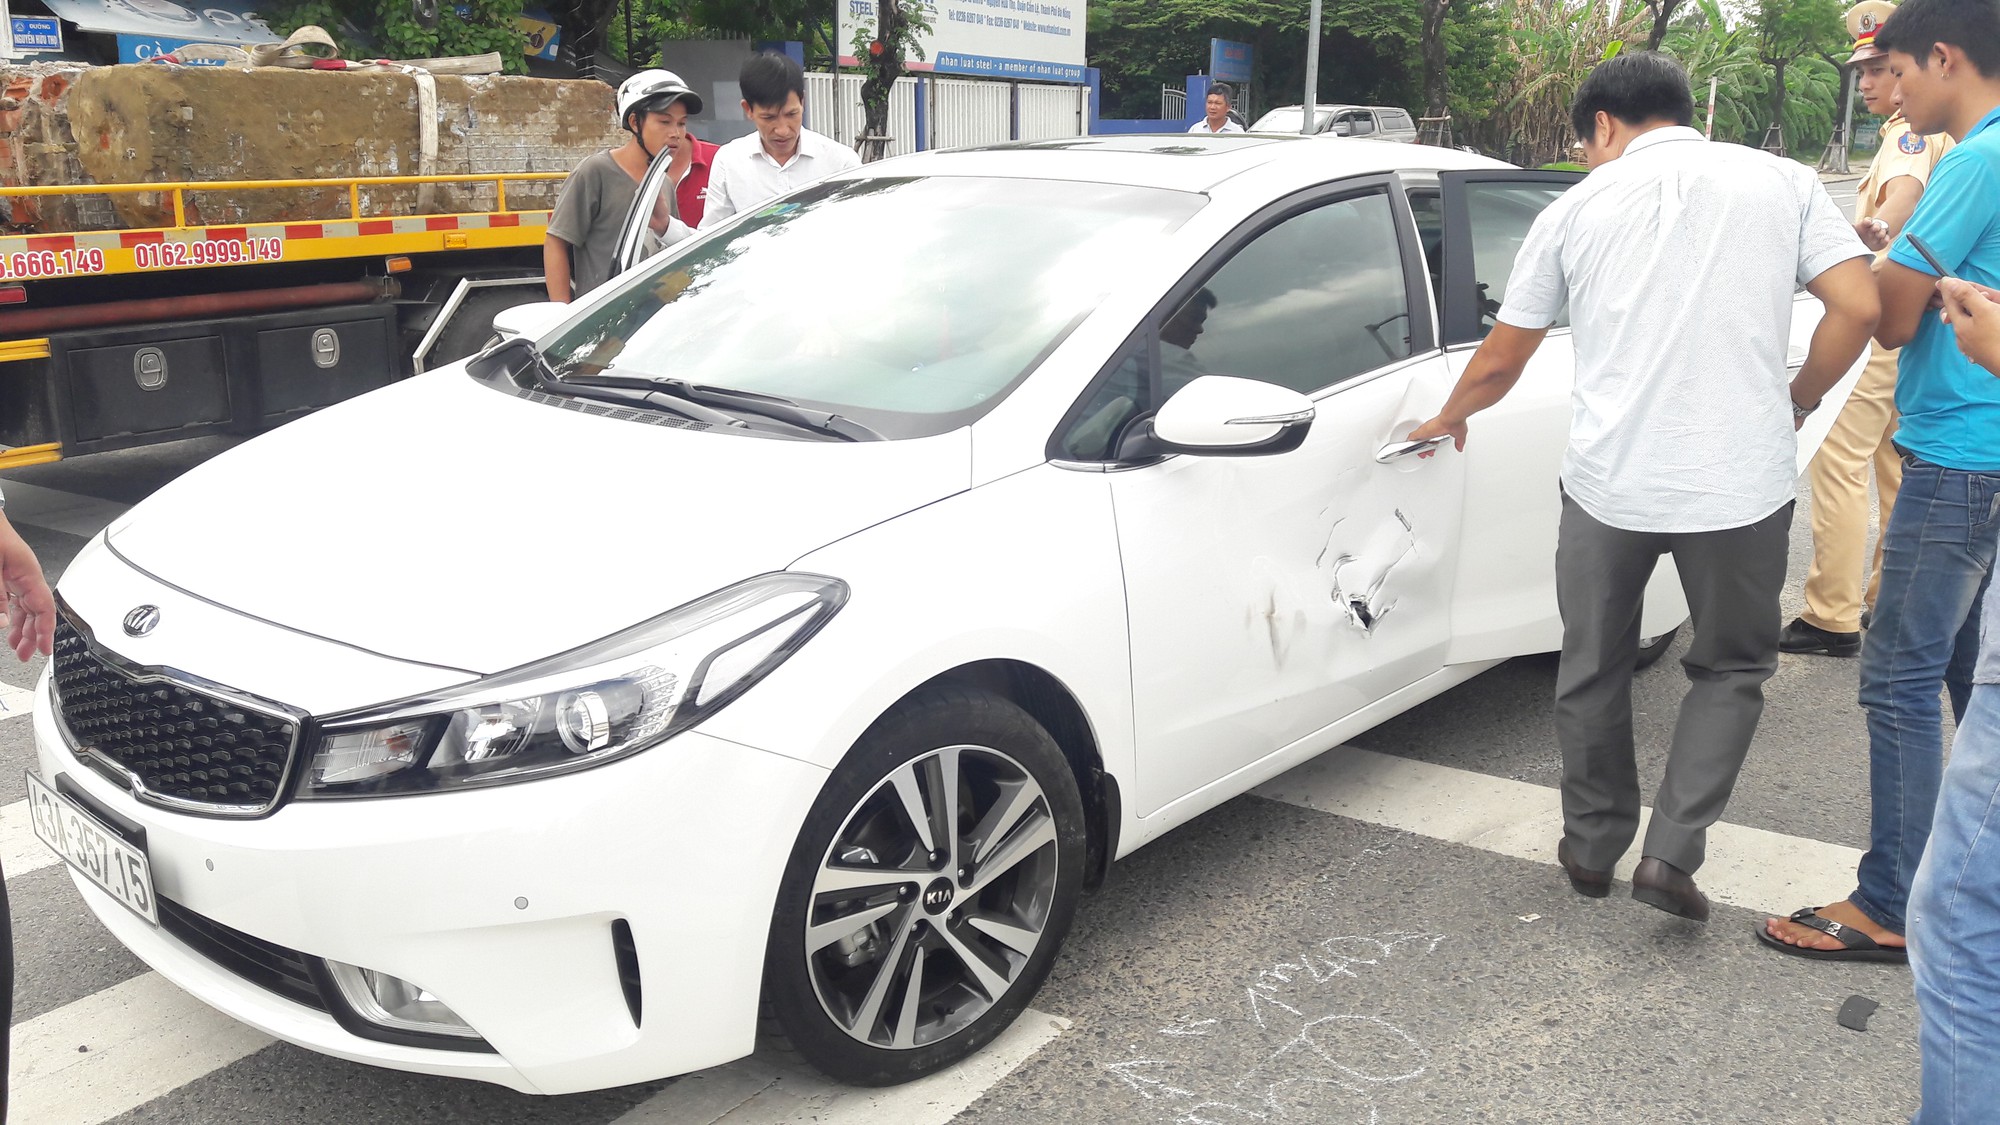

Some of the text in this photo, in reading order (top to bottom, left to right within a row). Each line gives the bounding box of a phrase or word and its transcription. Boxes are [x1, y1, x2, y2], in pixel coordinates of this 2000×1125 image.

[849, 0, 874, 16] STEEL
[134, 41, 164, 61] CÀ
[941, 56, 958, 67] nhan
[960, 57, 975, 68] luat
[976, 59, 993, 70] steel
[999, 62, 1003, 70] a
[1004, 63, 1028, 72] member
[1029, 64, 1036, 72] of
[1037, 64, 1051, 74] nhan
[1052, 66, 1064, 75] luat
[1065, 67, 1080, 78] group
[135, 237, 283, 269] 0162.9999.149
[127, 607, 157, 633] KIA
[31, 783, 149, 913] 43A-357.15
[926, 889, 951, 905] KIA
